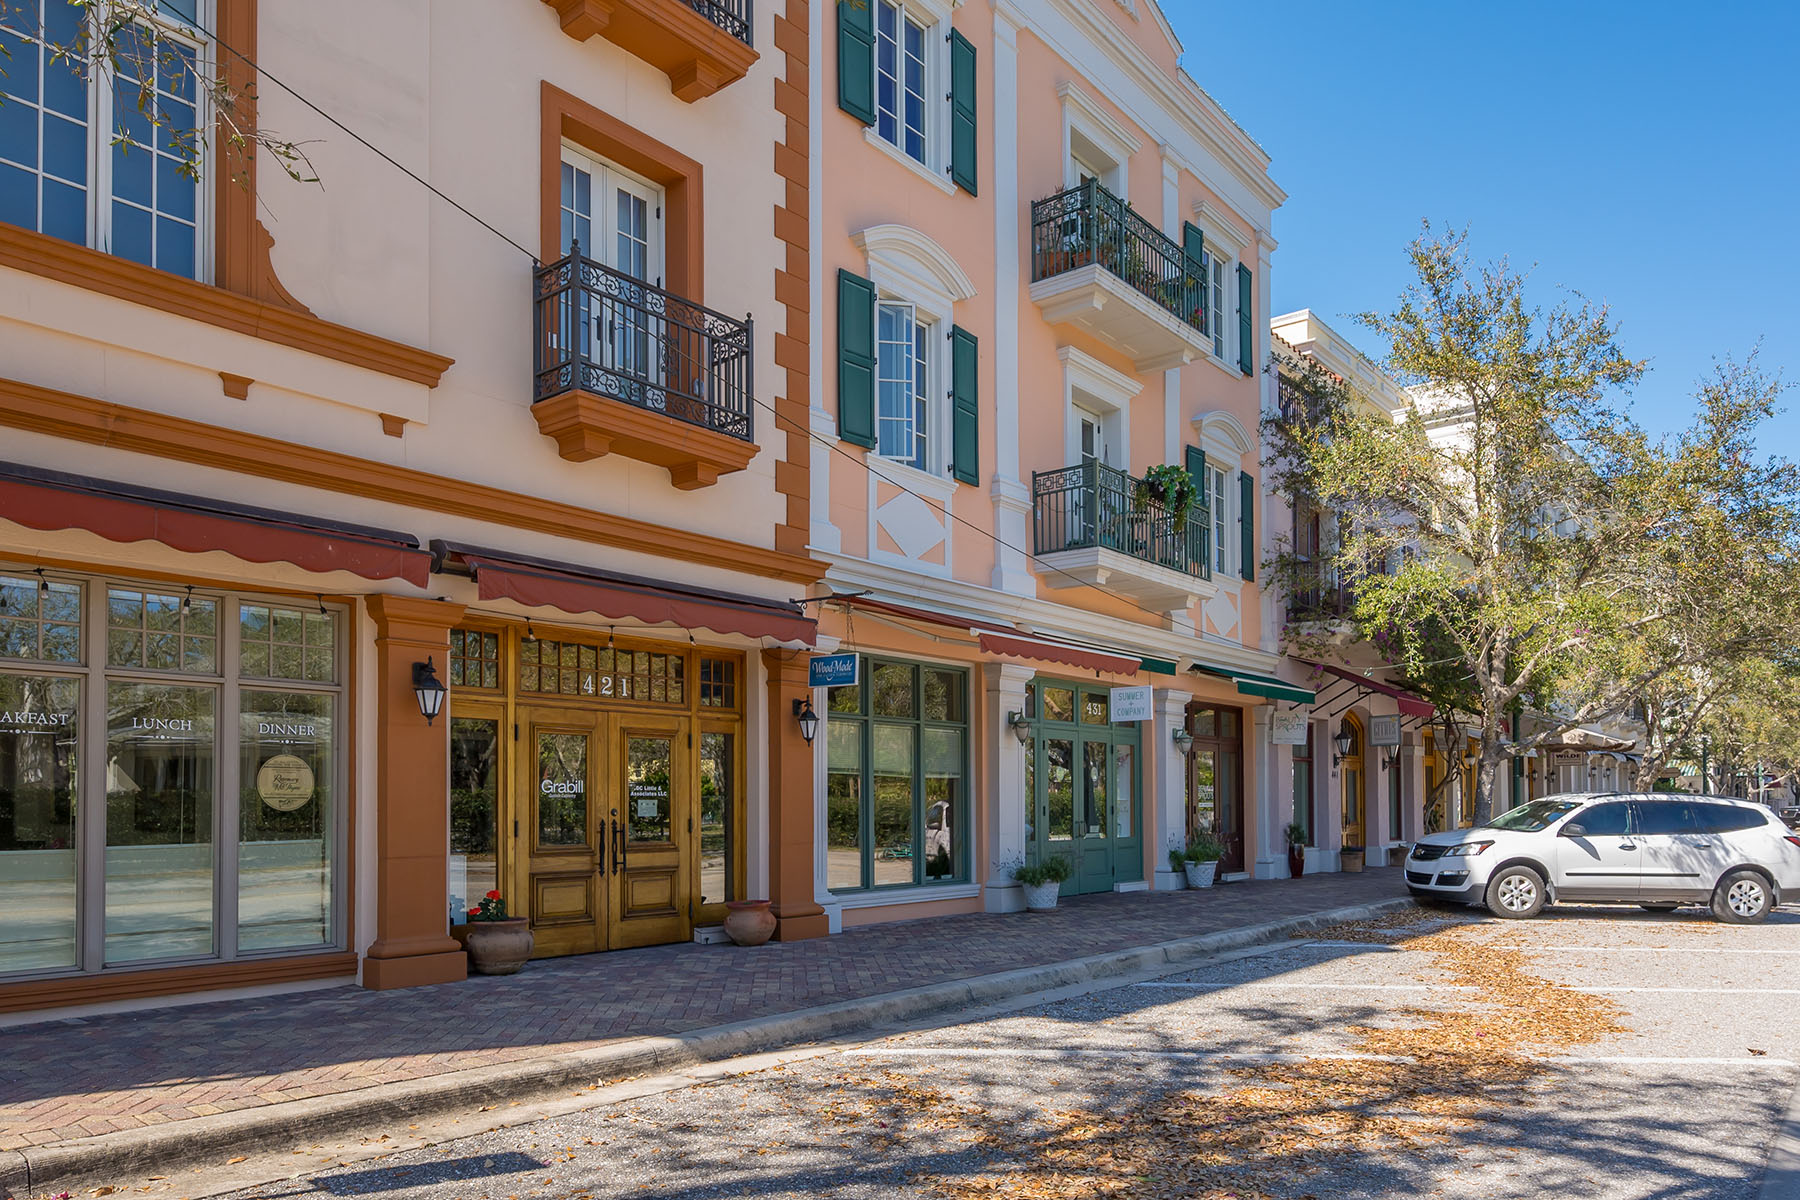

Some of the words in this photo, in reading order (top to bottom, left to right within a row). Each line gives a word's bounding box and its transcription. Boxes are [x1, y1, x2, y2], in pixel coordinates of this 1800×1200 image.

[583, 674, 628, 697] 421
[1118, 691, 1144, 701] SUMMER
[1086, 702, 1102, 716] 431
[1116, 707, 1145, 717] COMPANY
[132, 717, 192, 731] LUNCH
[258, 722, 315, 736] DINNER
[541, 779, 584, 794] Grabill
